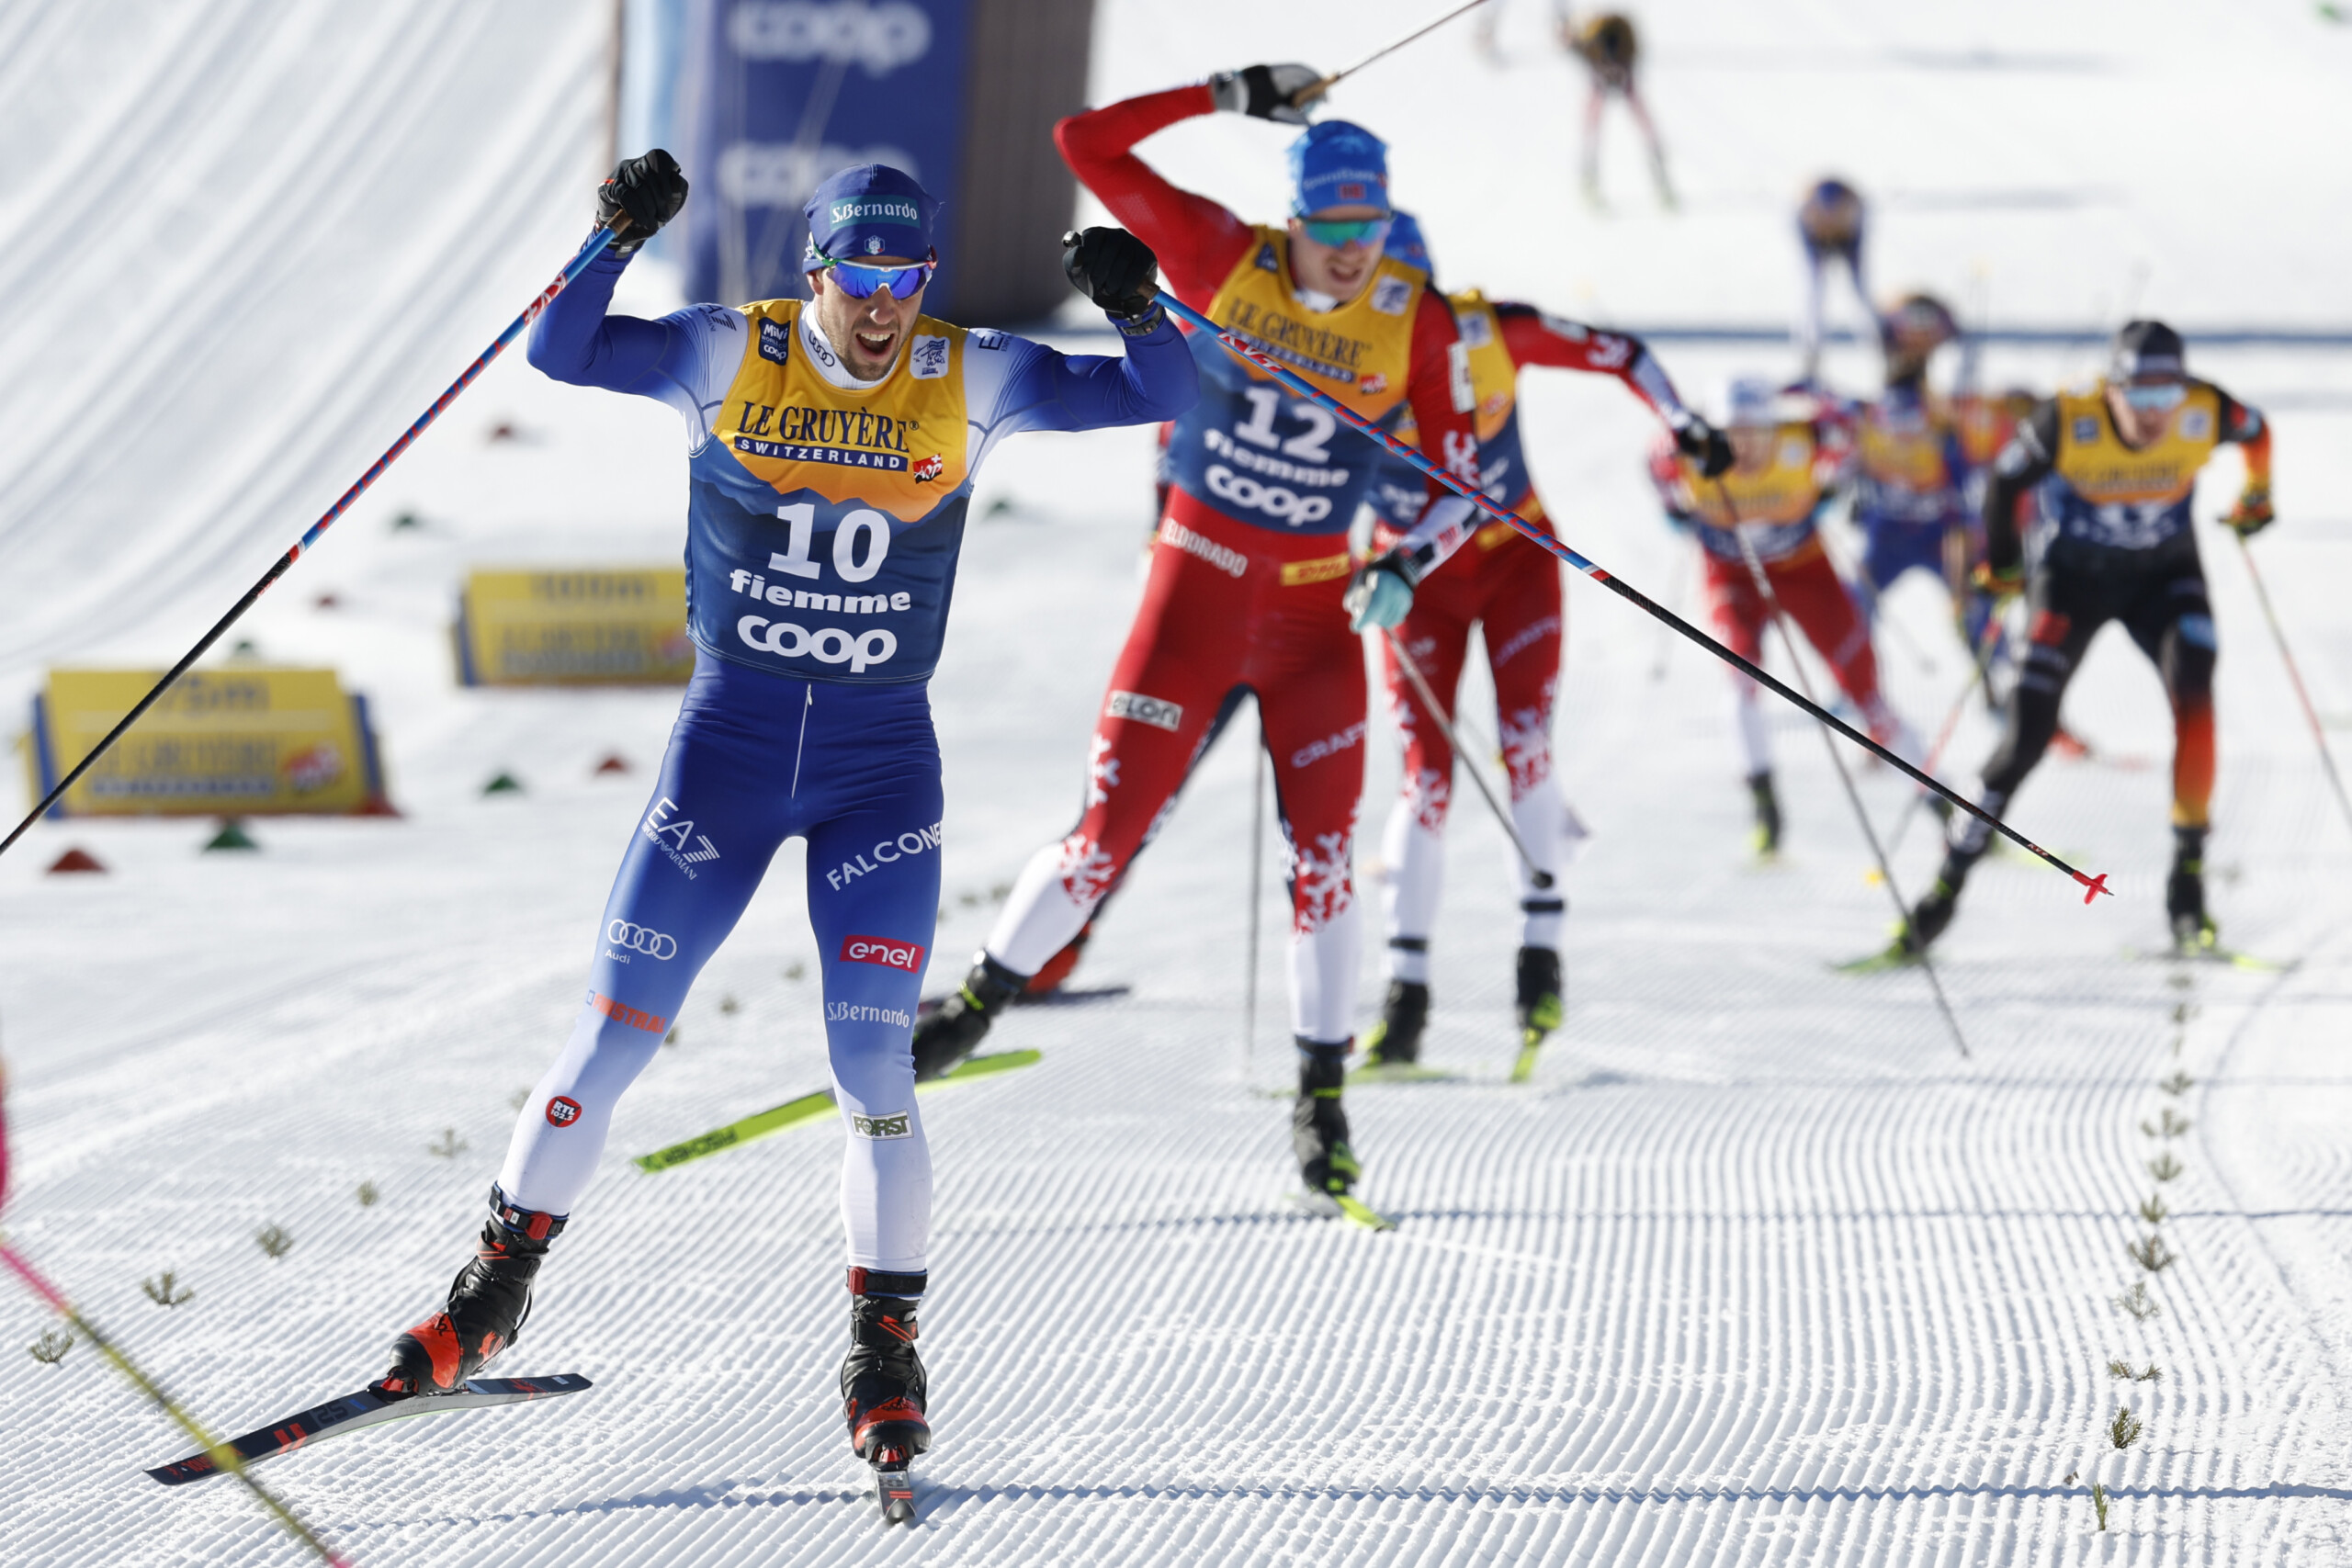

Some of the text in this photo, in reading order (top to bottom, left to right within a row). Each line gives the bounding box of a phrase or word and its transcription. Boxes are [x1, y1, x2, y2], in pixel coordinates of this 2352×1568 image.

[832, 203, 917, 223] S.Bernardo
[738, 401, 775, 435] LE
[1234, 386, 1336, 463] 12
[741, 439, 900, 468] SWITZERLAND
[1204, 428, 1350, 487] fiemme
[1205, 465, 1331, 526] coop
[768, 502, 890, 582] 10
[729, 569, 911, 614] fiemme
[737, 615, 898, 673] coop
[647, 796, 720, 863] EA7
[605, 948, 631, 964] Audi
[849, 942, 917, 969] enel
[828, 1001, 910, 1028] S.Bernardo
[550, 1109, 573, 1121] 102.5
[553, 1100, 575, 1115] RTL
[854, 1115, 909, 1136] FORST
